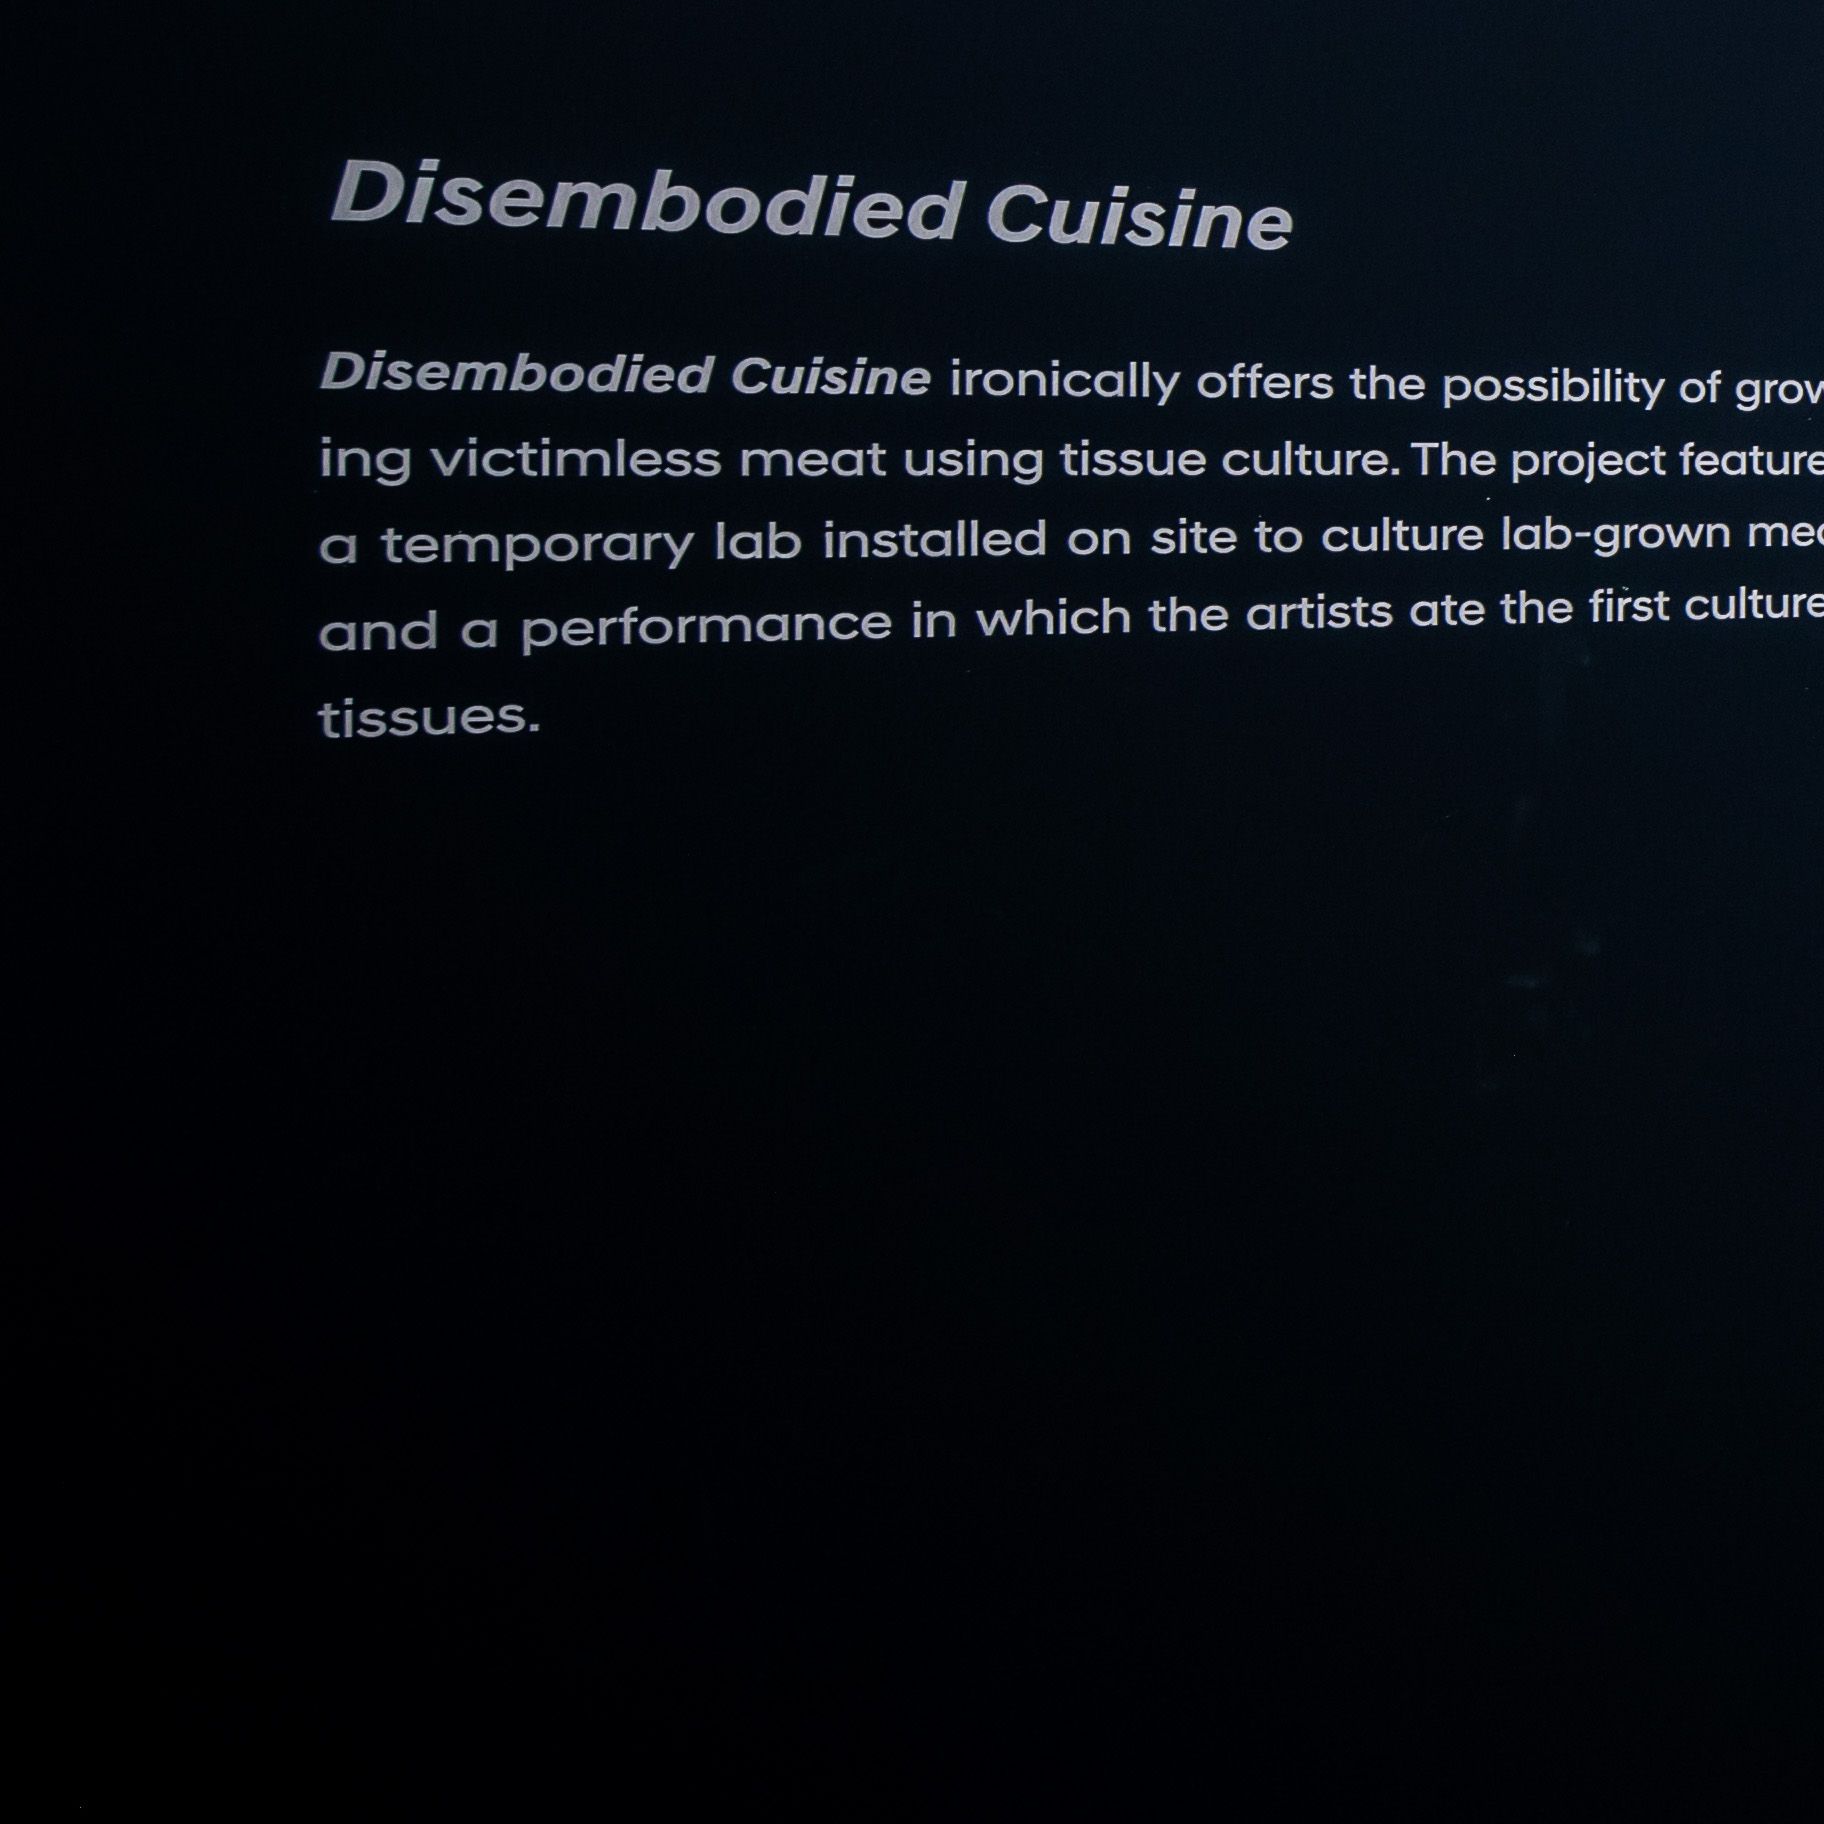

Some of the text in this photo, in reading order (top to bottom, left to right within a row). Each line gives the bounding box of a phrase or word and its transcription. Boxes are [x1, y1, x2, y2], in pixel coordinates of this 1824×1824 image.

[330, 158, 1294, 251] Disembodied Cuisine
[319, 349, 717, 394] Disembodied
[731, 355, 932, 396] Cuisine
[951, 357, 1182, 407] ironically
[1196, 362, 1334, 400] offers
[1347, 364, 1426, 401] the
[1442, 366, 1666, 411] possibility
[1678, 369, 1722, 404] of
[321, 436, 411, 487] ing
[429, 436, 722, 478] victimless
[740, 442, 887, 477] meat
[904, 438, 1043, 486] using
[1058, 438, 1207, 477] tissue
[1221, 440, 1400, 477] culture.
[1409, 440, 1497, 476] The
[1511, 440, 1667, 484] project
[319, 534, 357, 565] a
[379, 527, 696, 572] temporary
[716, 521, 802, 560] lab
[824, 518, 1046, 559] installed
[1066, 527, 1131, 556] on
[1150, 517, 1238, 555] site
[1252, 520, 1303, 554] to
[1320, 515, 1485, 553] culture
[1501, 515, 1731, 558] lab-grown
[318, 609, 437, 652] and
[461, 619, 497, 649] a
[522, 605, 892, 657] performance
[912, 600, 956, 639] in
[975, 597, 1131, 637] which
[1147, 595, 1229, 633] the
[1245, 592, 1394, 631] artists
[1408, 594, 1486, 627] ate
[1498, 589, 1574, 625] the
[1587, 585, 1671, 623] first
[316, 697, 540, 739] tissues.
